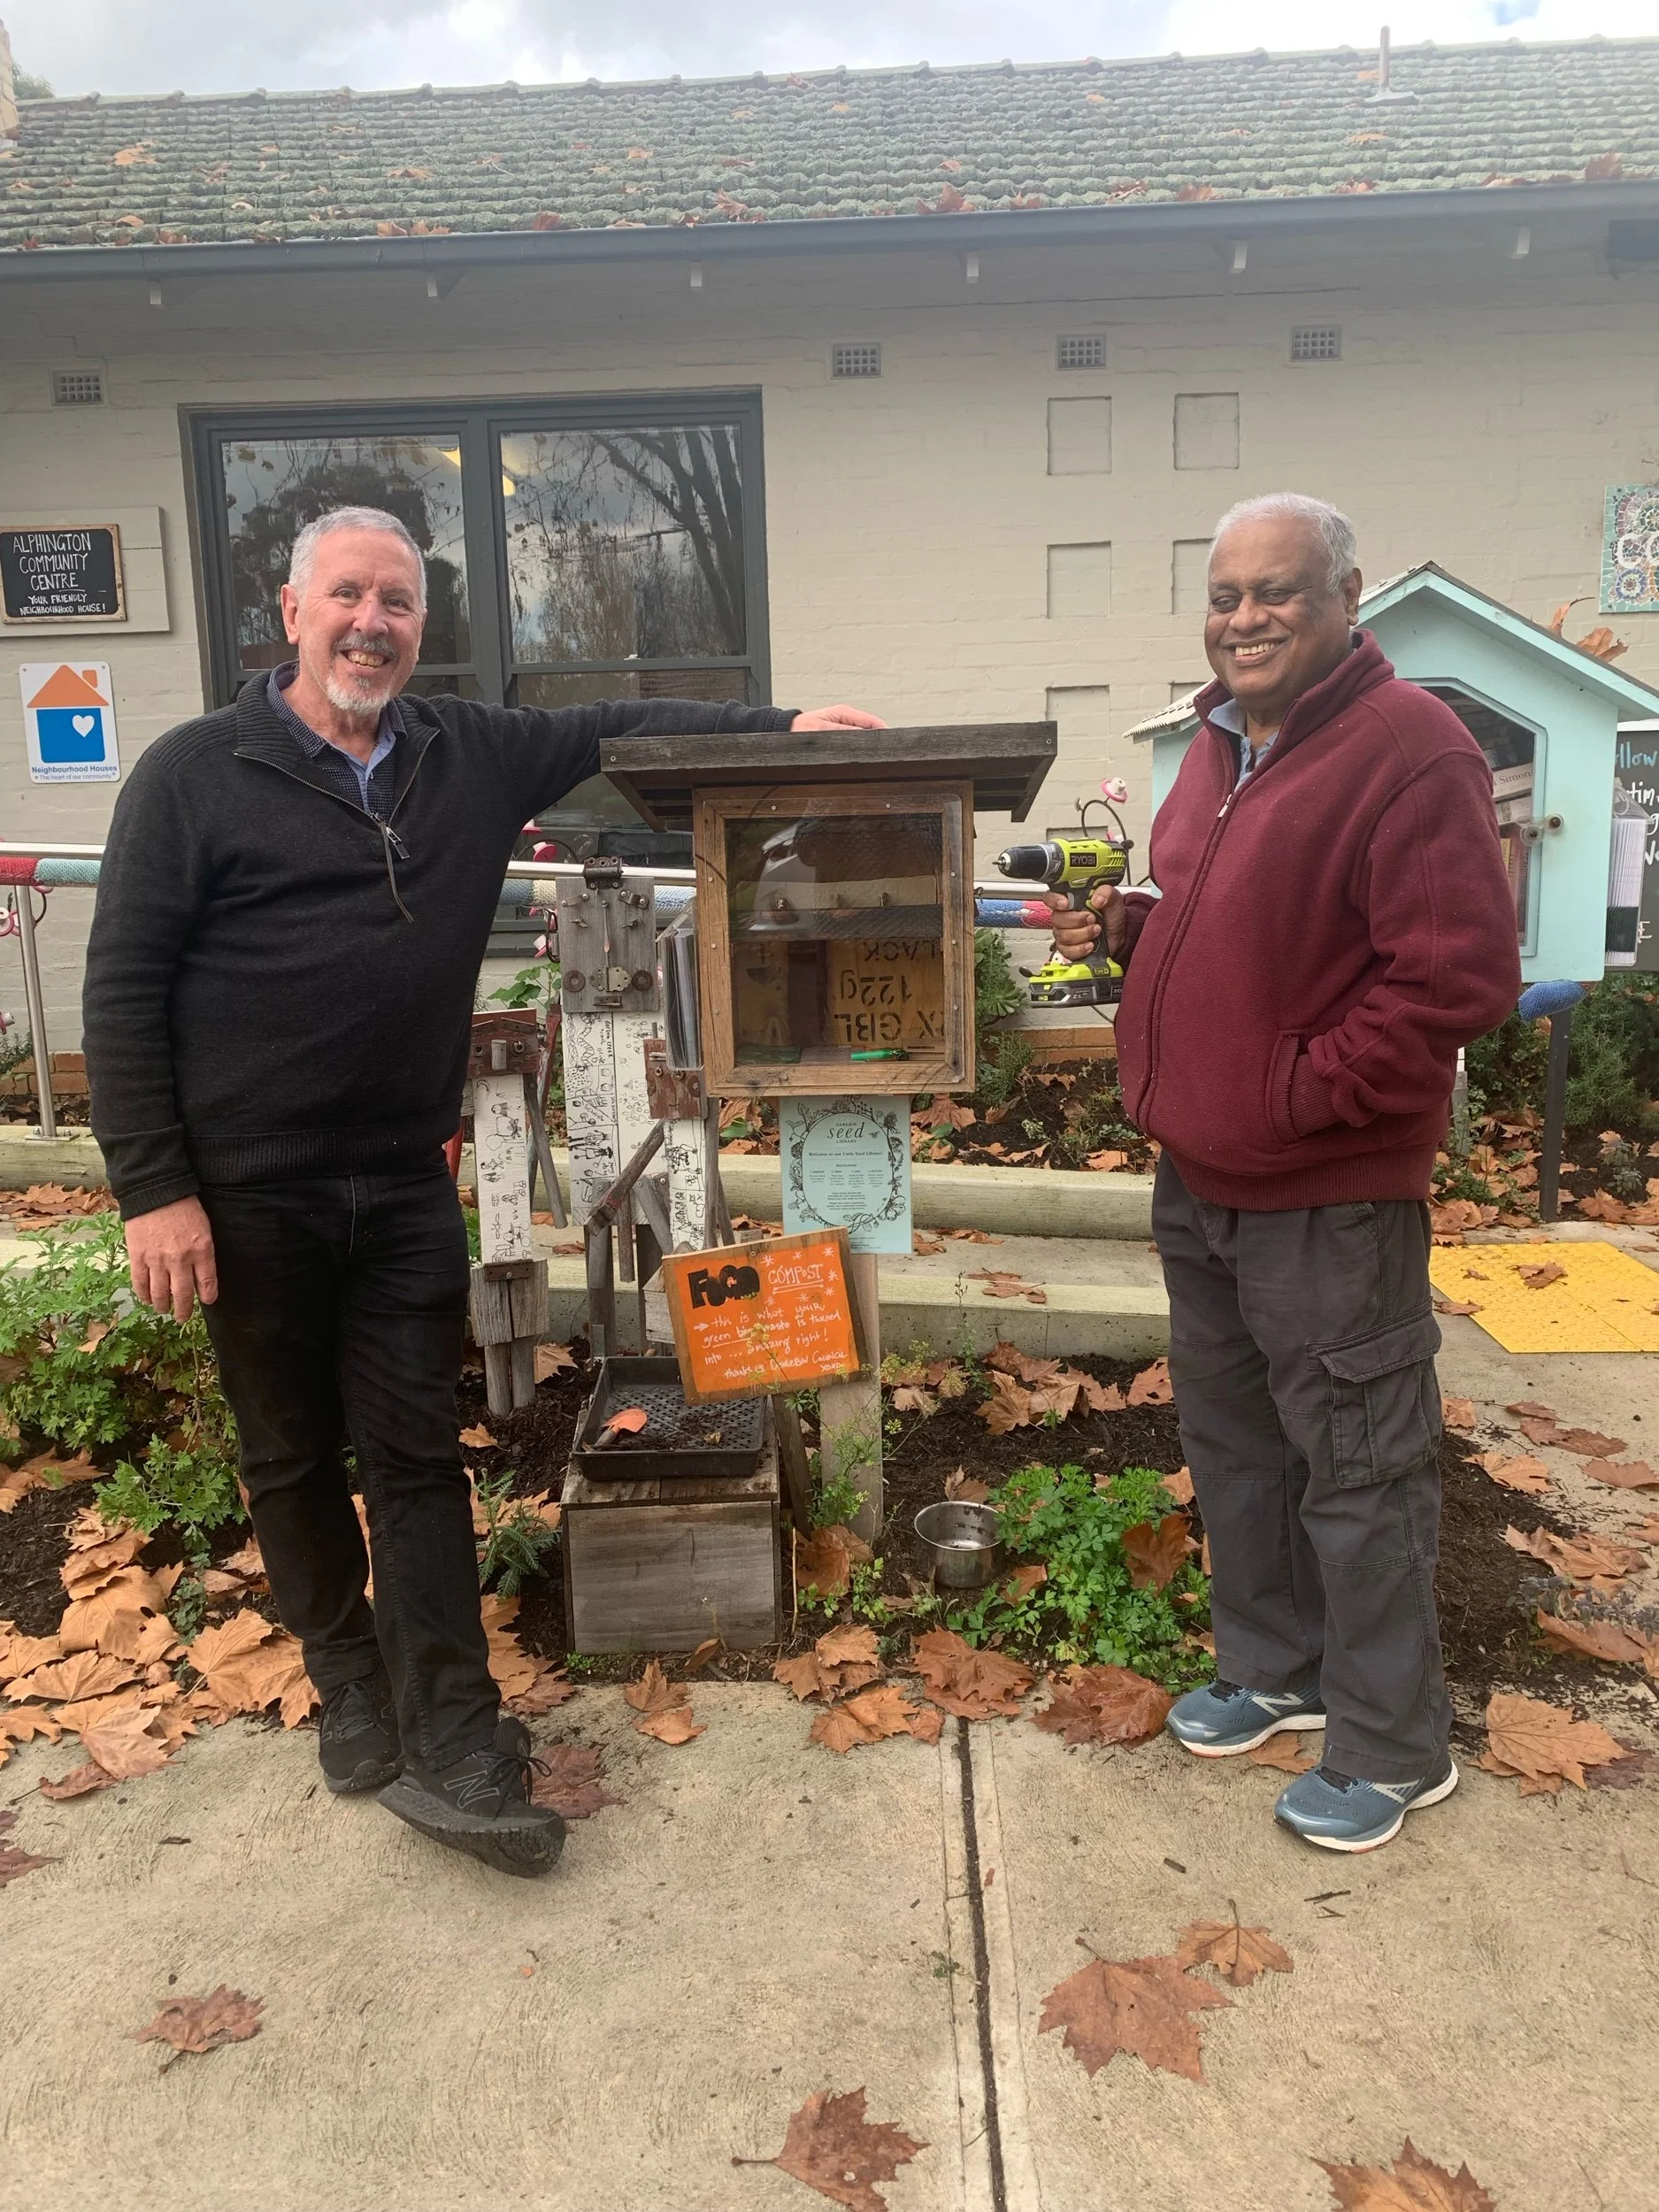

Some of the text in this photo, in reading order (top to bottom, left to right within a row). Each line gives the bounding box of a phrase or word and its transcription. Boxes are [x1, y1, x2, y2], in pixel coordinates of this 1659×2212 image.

[13, 532, 91, 554] ALPHINGTON
[19, 552, 88, 573] COMMUNITY
[30, 572, 79, 591] CENTRE
[50, 593, 88, 603] FRIENDLY
[19, 605, 74, 616] NEIGHBOURHOOD
[1615, 741, 1658, 769] llow
[32, 765, 88, 774] Neighbourhood
[1625, 781, 1659, 806] tim
[1071, 855, 1096, 866] RYOBI
[862, 941, 944, 962] LACK
[841, 970, 912, 1007] 122g
[826, 1121, 865, 1140] seed
[687, 1264, 761, 1310] FOOD
[711, 1314, 733, 1328] this
[740, 1311, 749, 1324] is
[757, 1307, 784, 1320] what
[702, 1333, 731, 1348] green
[704, 1352, 722, 1365] into
[747, 1335, 791, 1355] amazing
[725, 1365, 752, 1379] thanks
